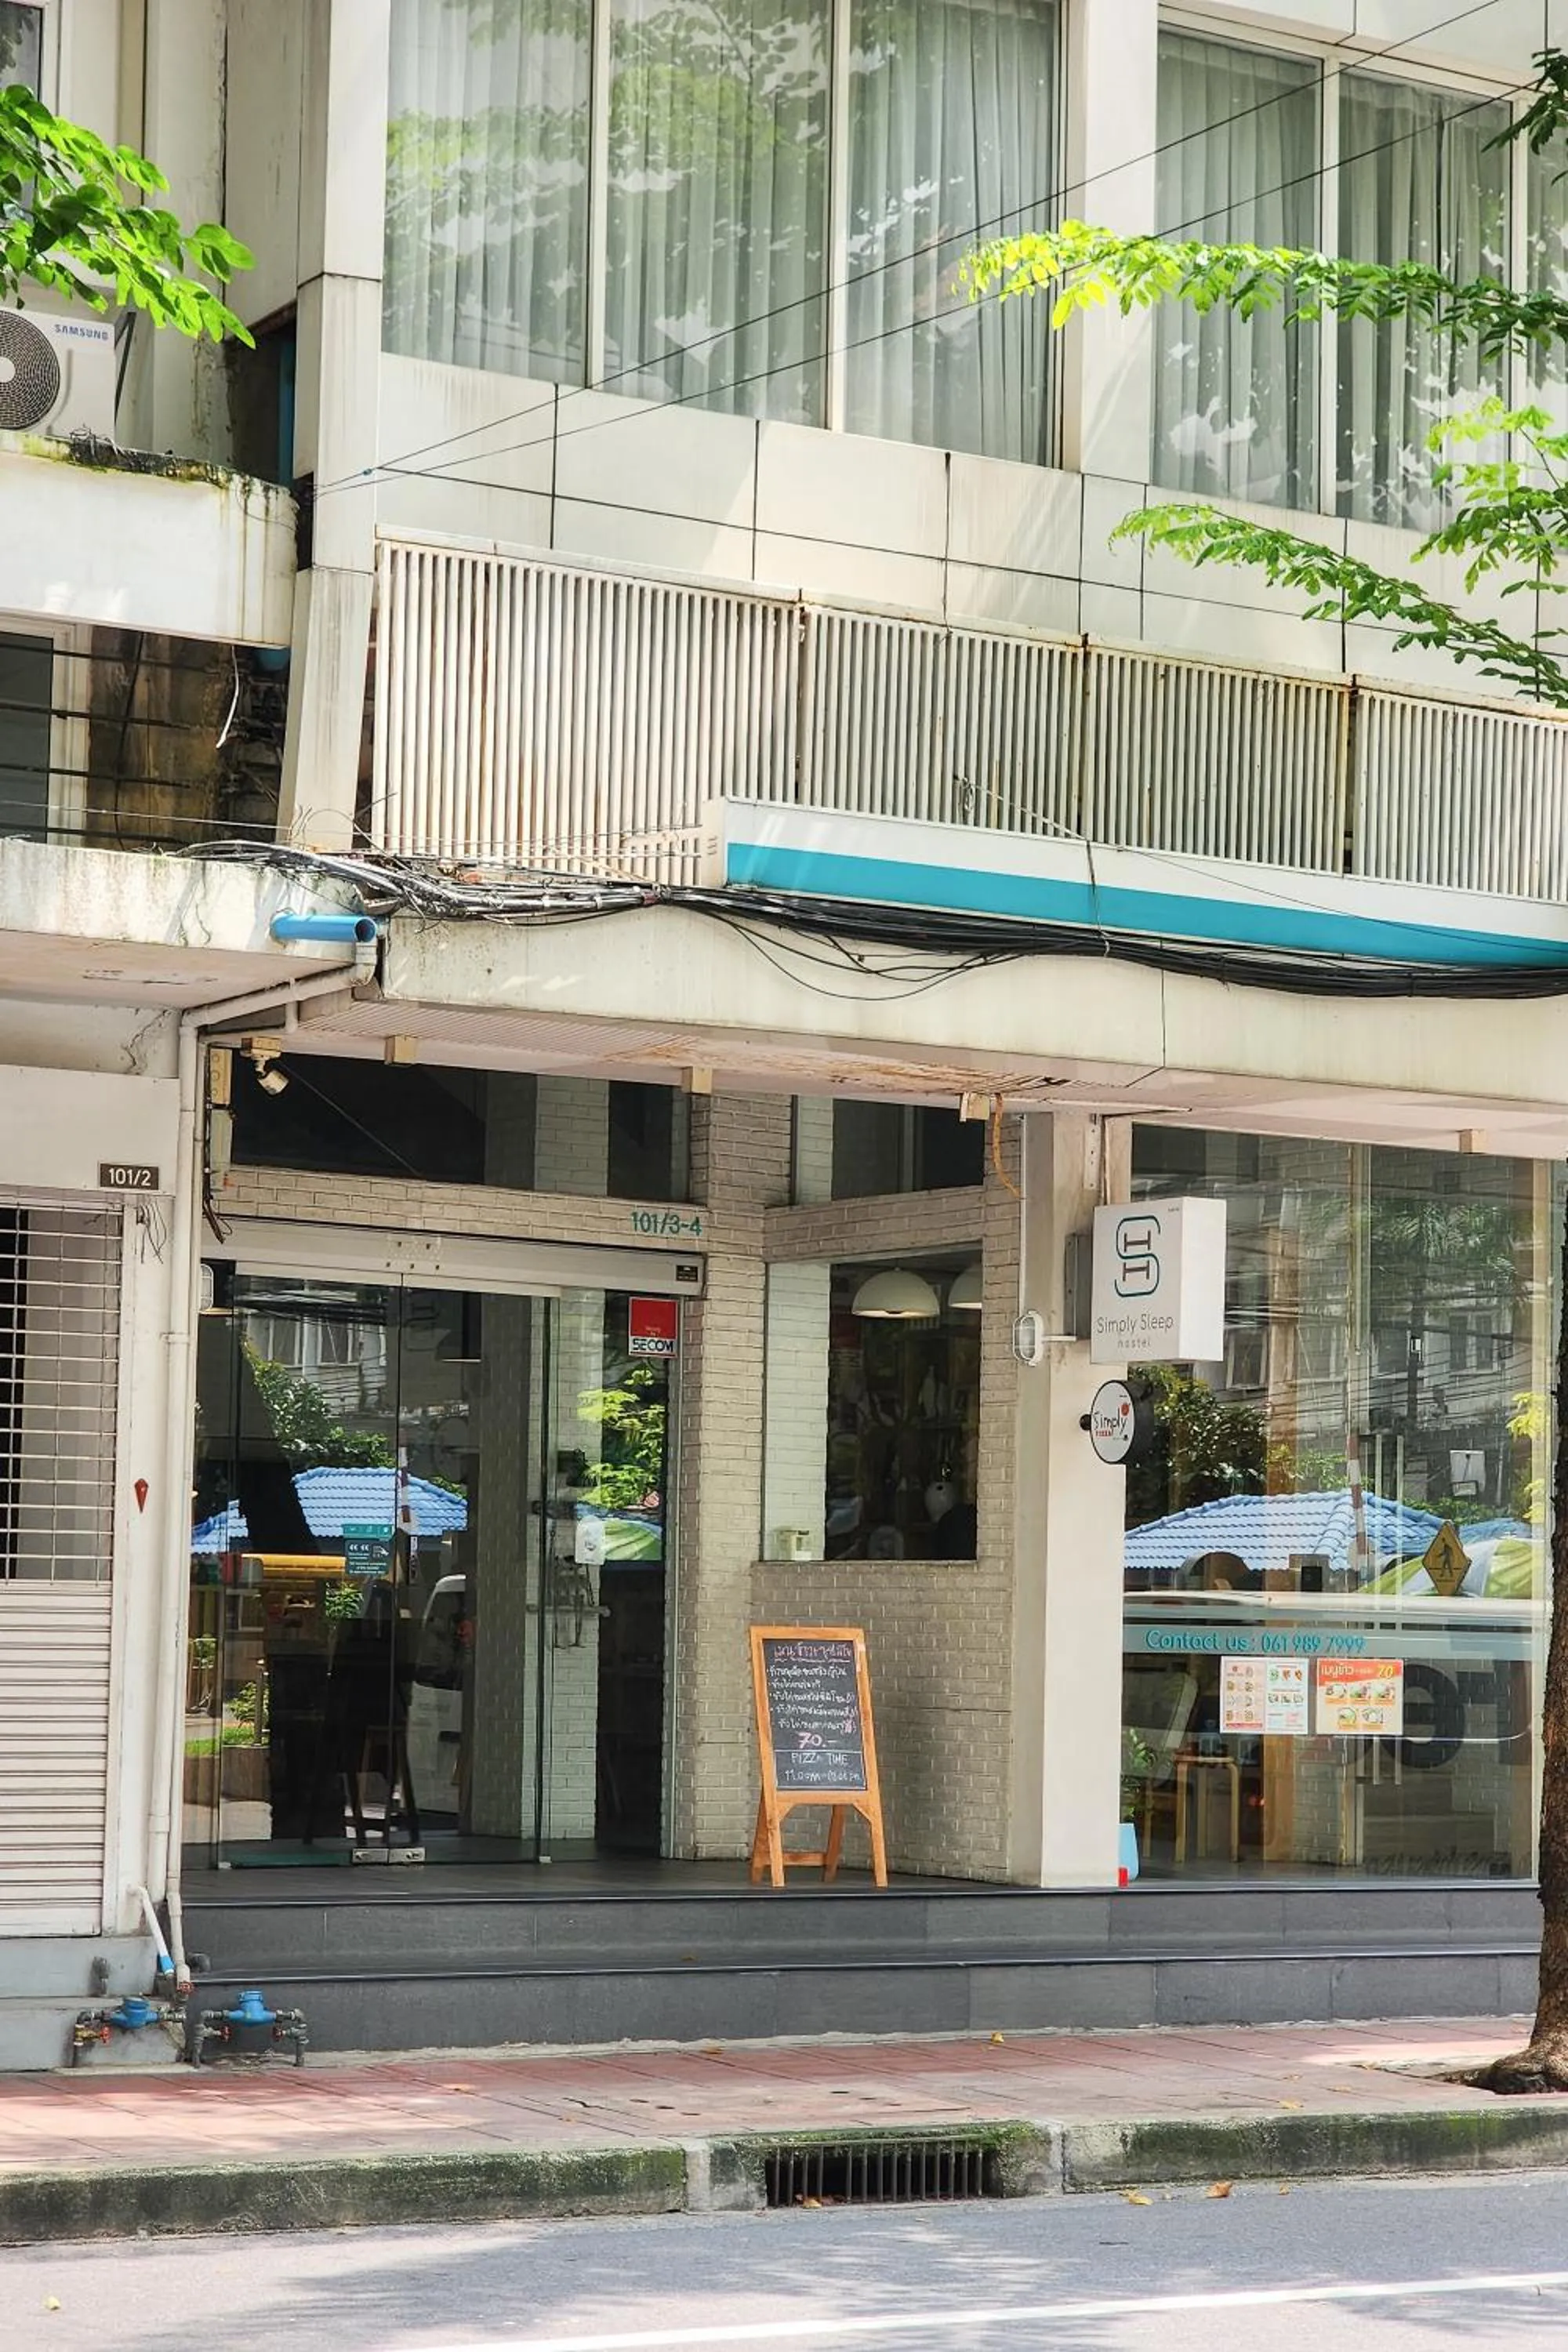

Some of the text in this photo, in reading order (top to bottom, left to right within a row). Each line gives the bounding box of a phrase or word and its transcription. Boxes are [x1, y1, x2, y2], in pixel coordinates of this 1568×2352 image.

[54, 323, 109, 341] SAMSUNG
[108, 1167, 151, 1186] 101/2
[630, 1211, 702, 1236] 101/3-4
[1097, 1312, 1174, 1335] Simply Sleep
[632, 1338, 674, 1353] SECOM
[1093, 1407, 1128, 1436] Simply
[1145, 1630, 1218, 1650] Contact
[1261, 1633, 1287, 1653] 061
[1292, 1636, 1321, 1653] 989
[1327, 1636, 1366, 1654] 7999
